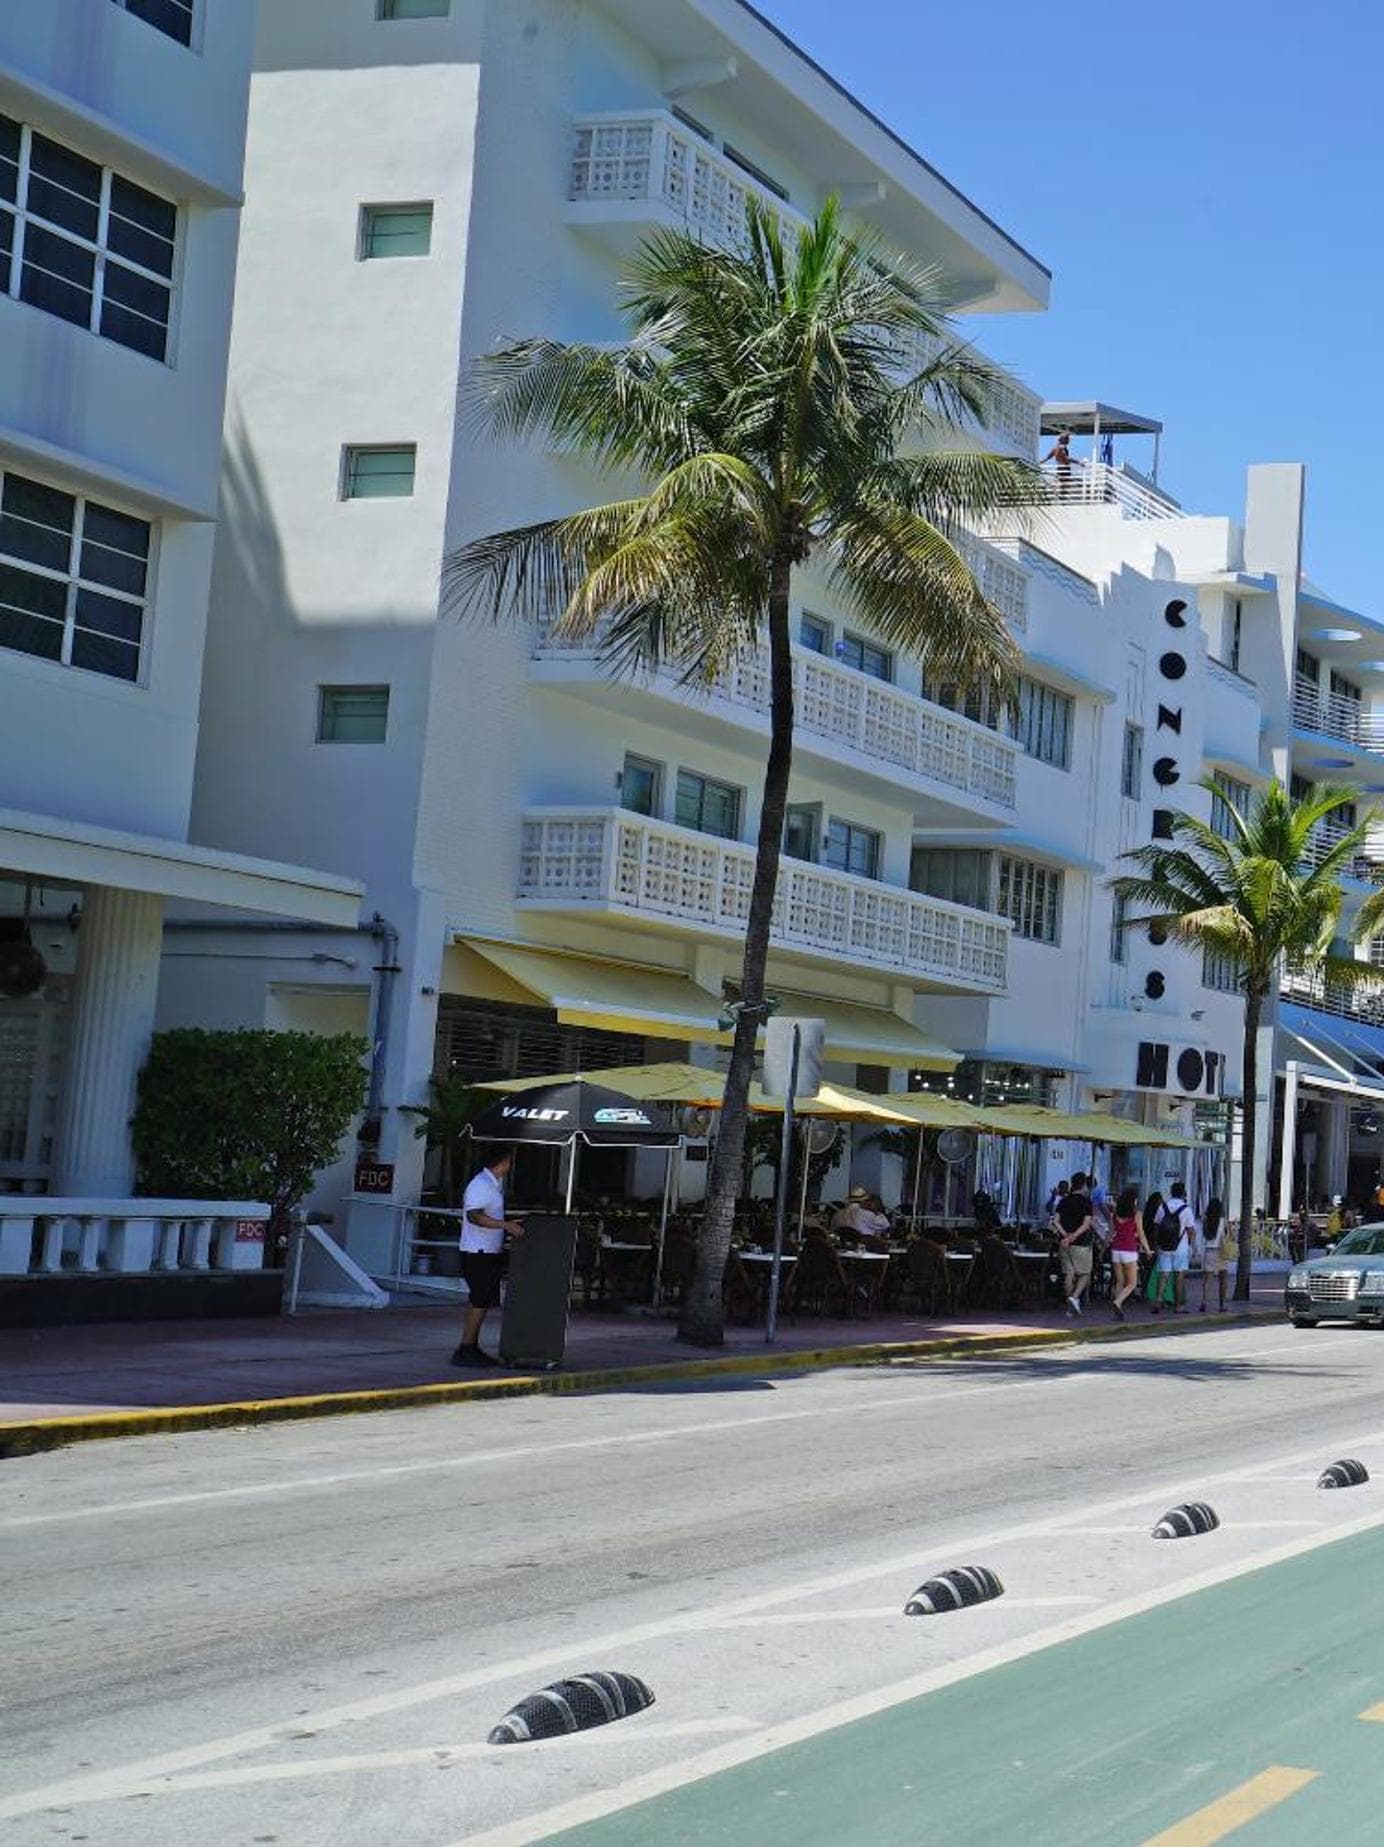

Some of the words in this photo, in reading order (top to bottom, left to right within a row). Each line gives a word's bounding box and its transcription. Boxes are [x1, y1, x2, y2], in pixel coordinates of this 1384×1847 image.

[501, 1106, 569, 1121] VALET
[358, 1170, 389, 1187] FDC
[238, 1222, 264, 1238] FDC
